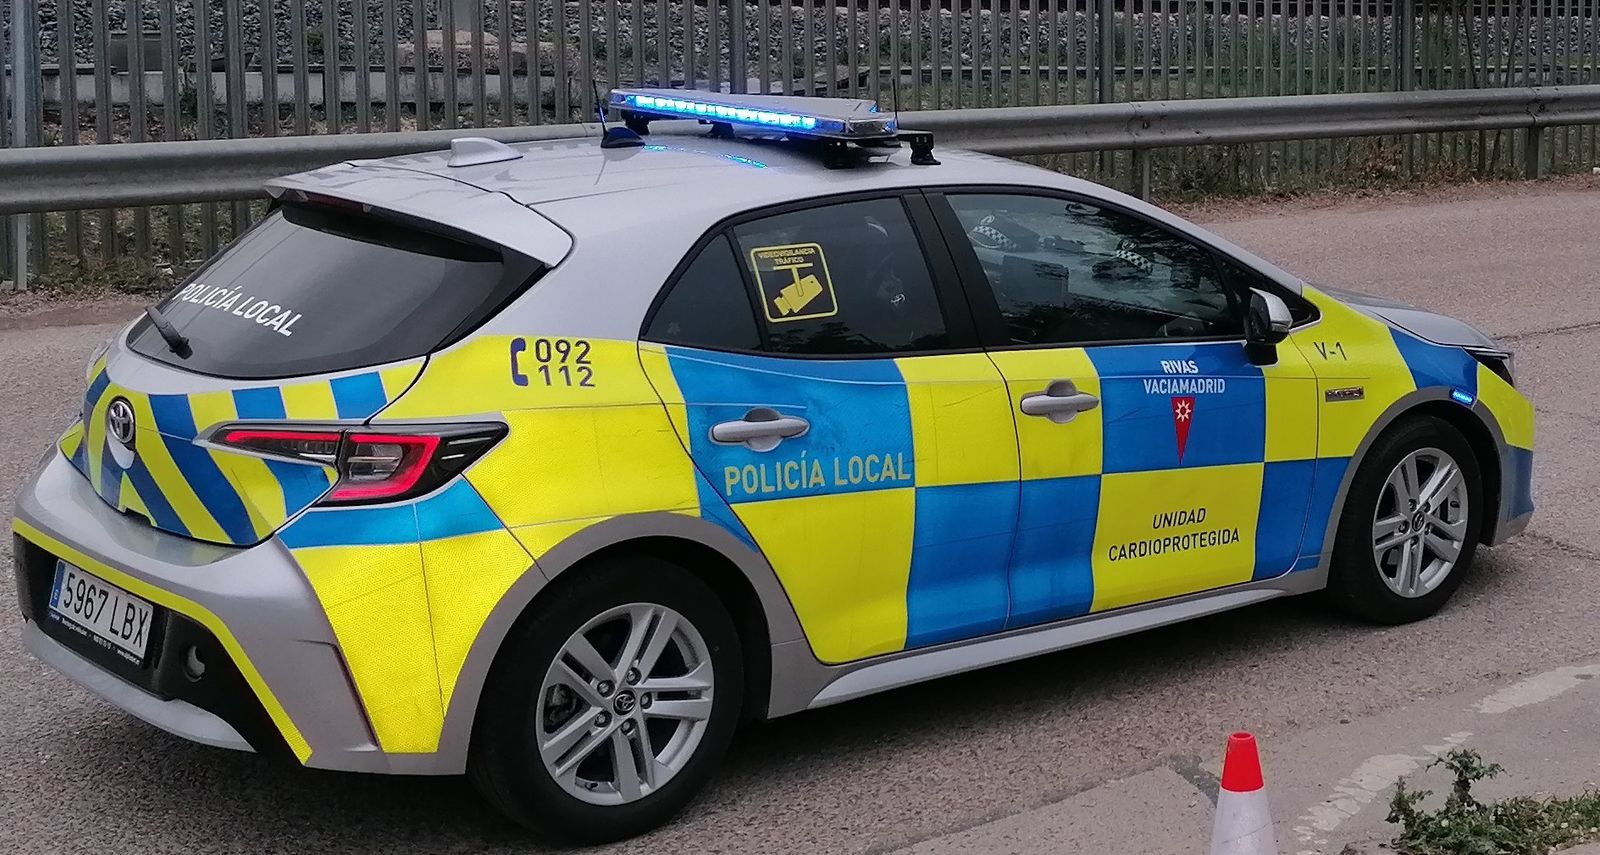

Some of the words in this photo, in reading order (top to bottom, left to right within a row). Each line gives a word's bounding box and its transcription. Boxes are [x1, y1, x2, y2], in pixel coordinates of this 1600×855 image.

[172, 283, 243, 312] POLICÍA
[232, 296, 303, 337] LOCAL
[535, 338, 592, 365] 092
[1313, 341, 1348, 361] V-1
[538, 364, 596, 387] 112
[1160, 360, 1199, 374] RIVAS
[1143, 378, 1226, 394] VACIAMADRID
[724, 450, 826, 496] POLICÍA
[834, 452, 912, 486] LOCAL
[1152, 507, 1206, 529] UNIDAD
[1108, 527, 1240, 561] CARDIOPROTEGIDA
[63, 572, 109, 624] 5967
[109, 596, 149, 648] LBX
